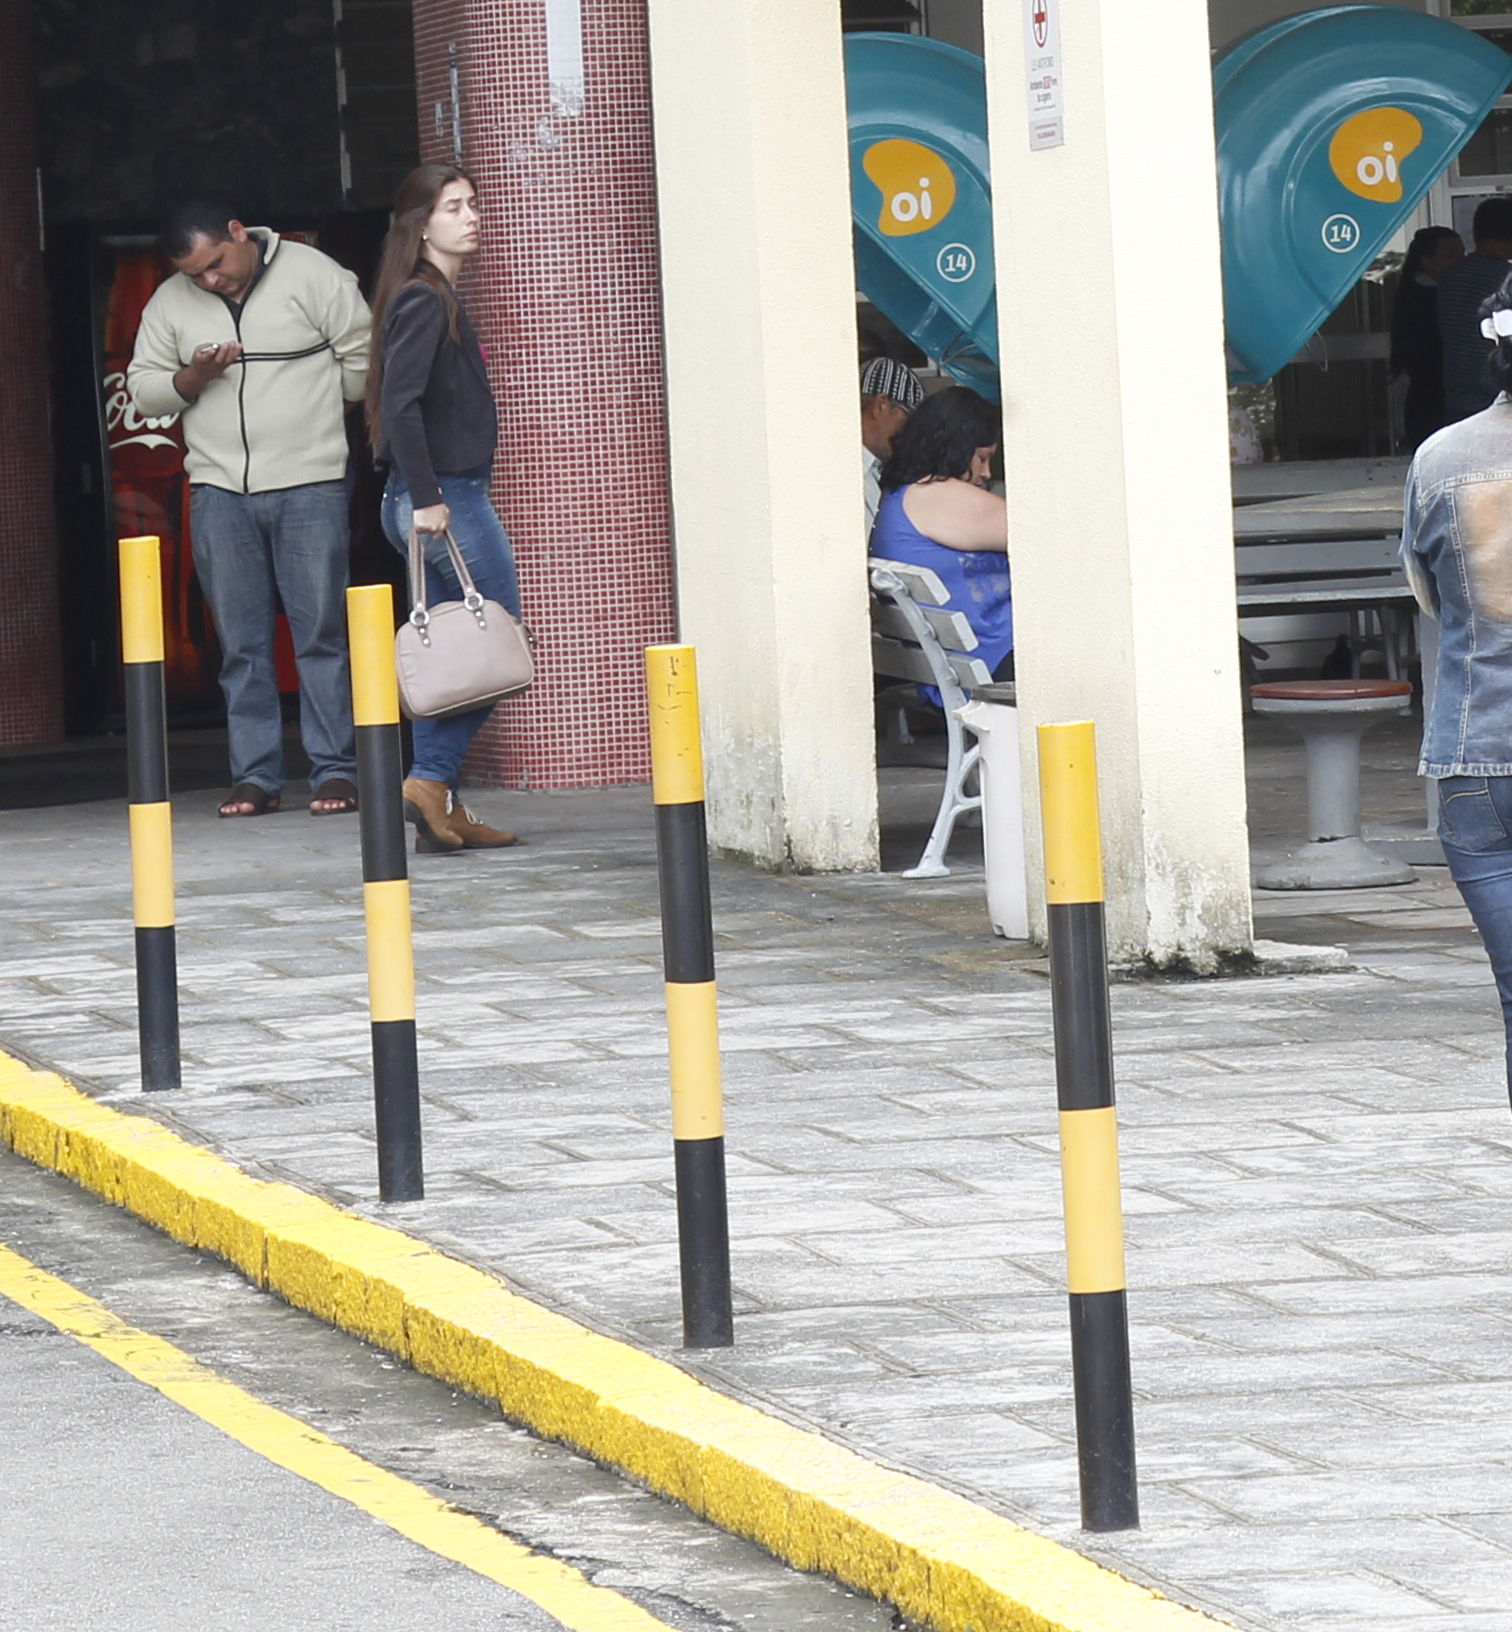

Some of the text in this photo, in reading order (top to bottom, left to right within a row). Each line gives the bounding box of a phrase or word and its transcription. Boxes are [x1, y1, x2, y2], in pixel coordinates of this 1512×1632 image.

[1356, 140, 1397, 186] oi
[891, 176, 932, 222] oi
[1330, 224, 1352, 243] 14
[944, 253, 968, 272] 14
